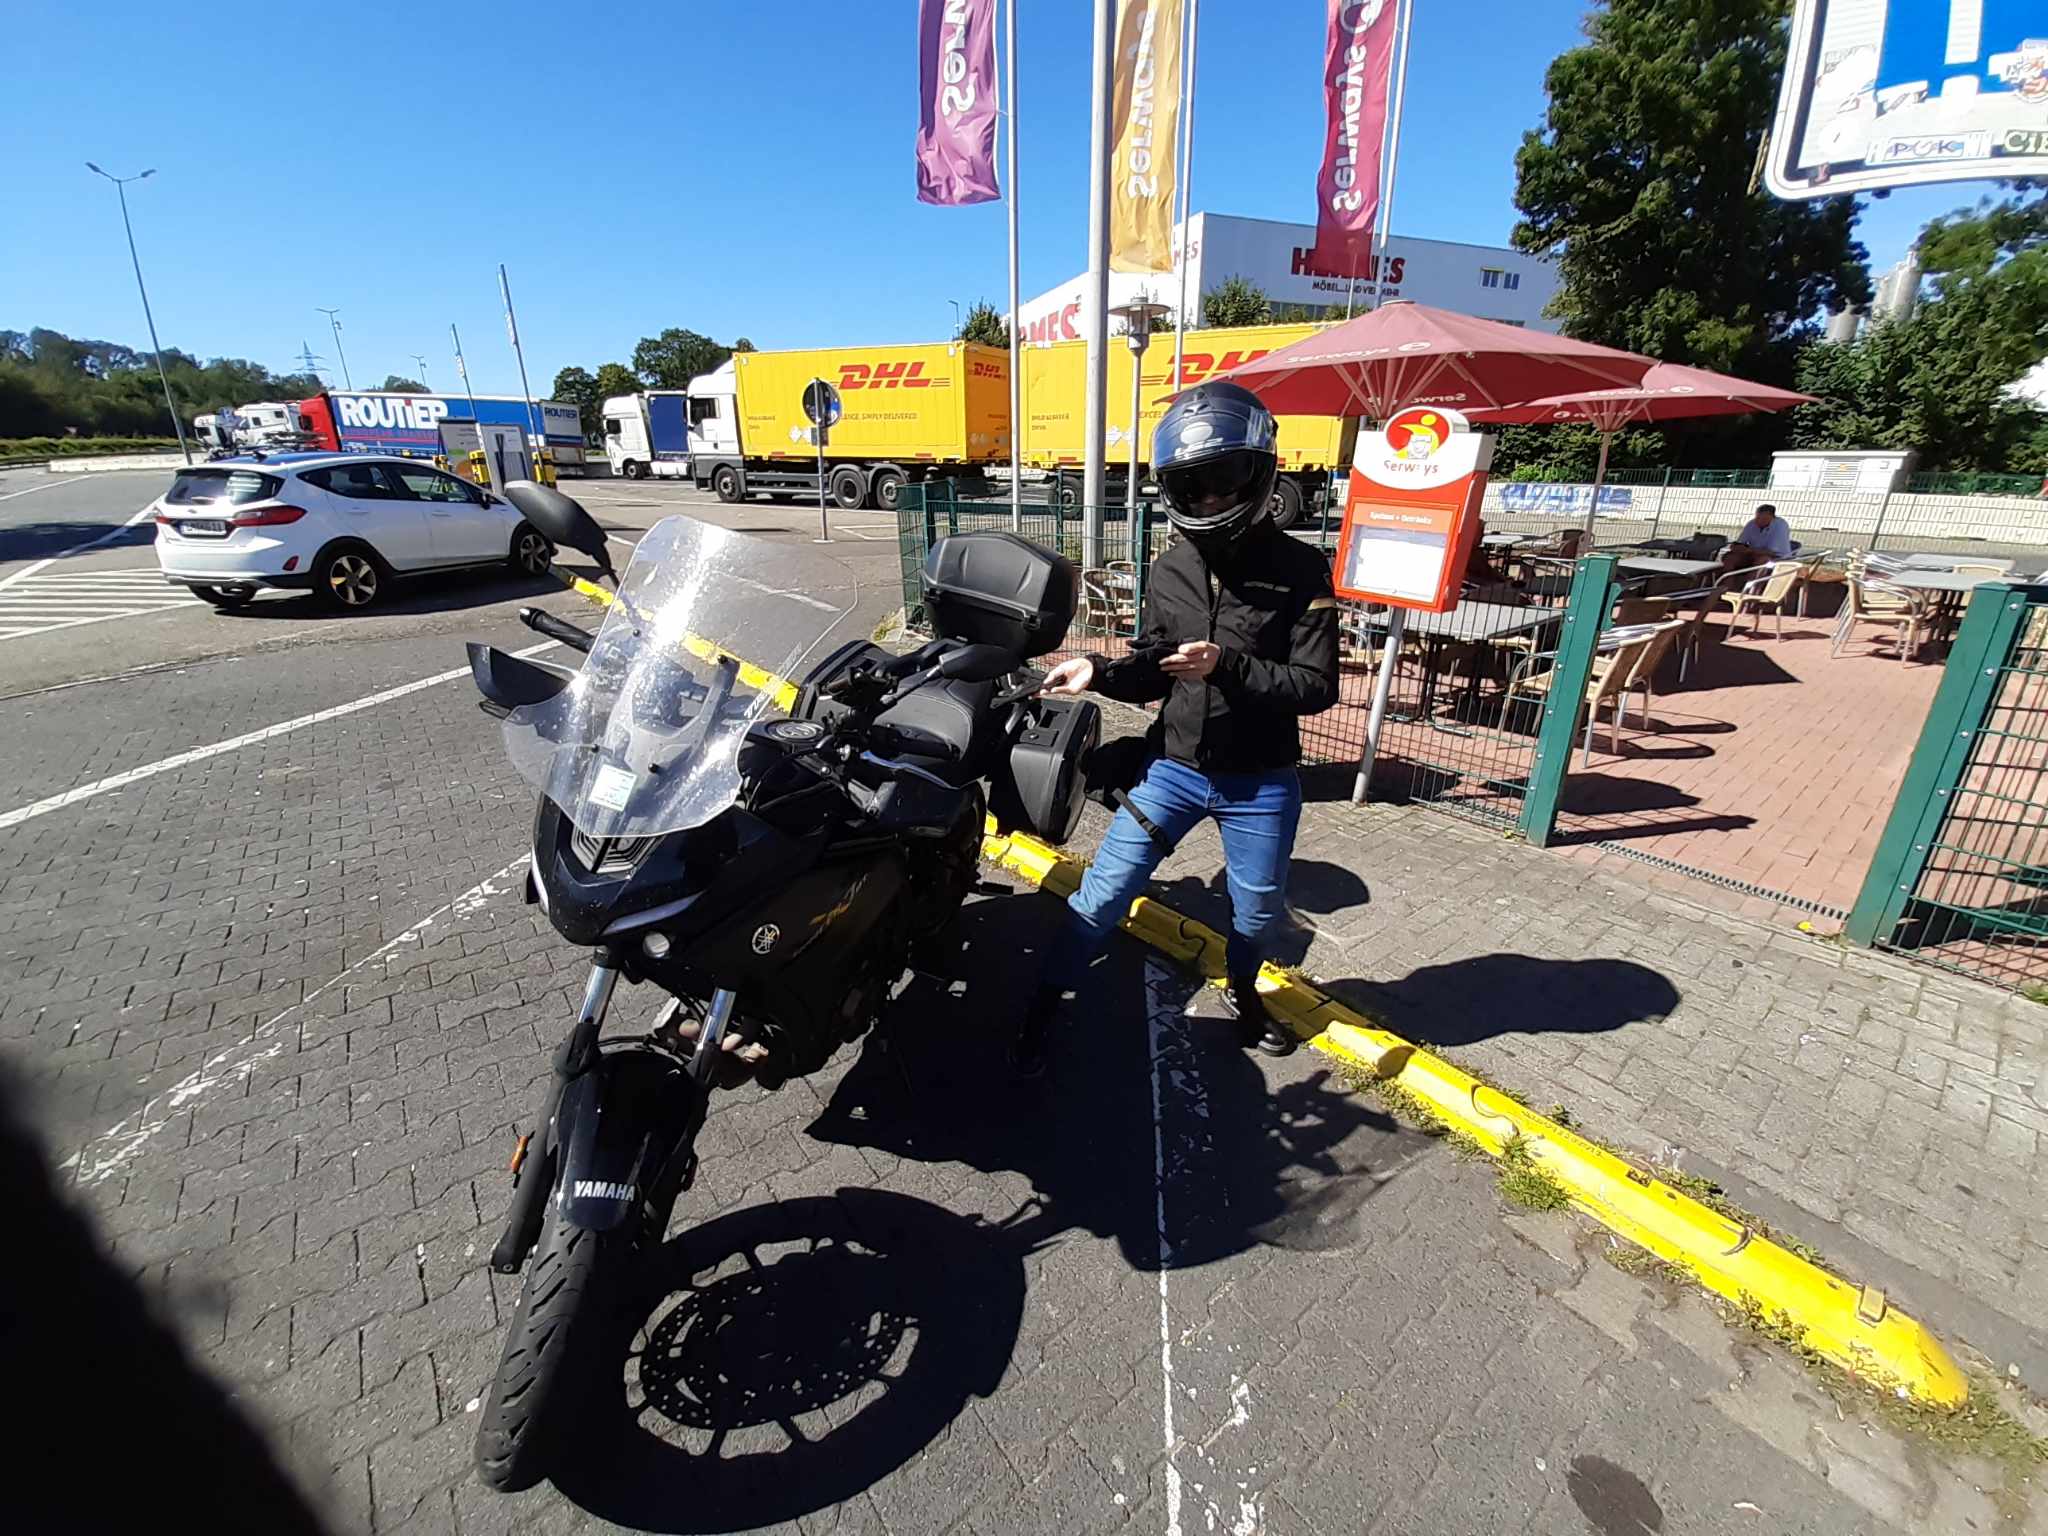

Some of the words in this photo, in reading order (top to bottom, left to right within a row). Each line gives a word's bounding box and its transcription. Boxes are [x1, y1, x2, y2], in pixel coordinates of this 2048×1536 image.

[838, 361, 932, 391] DHL
[1383, 459, 1439, 477] Serwys
[573, 1180, 636, 1202] YAMAHA
